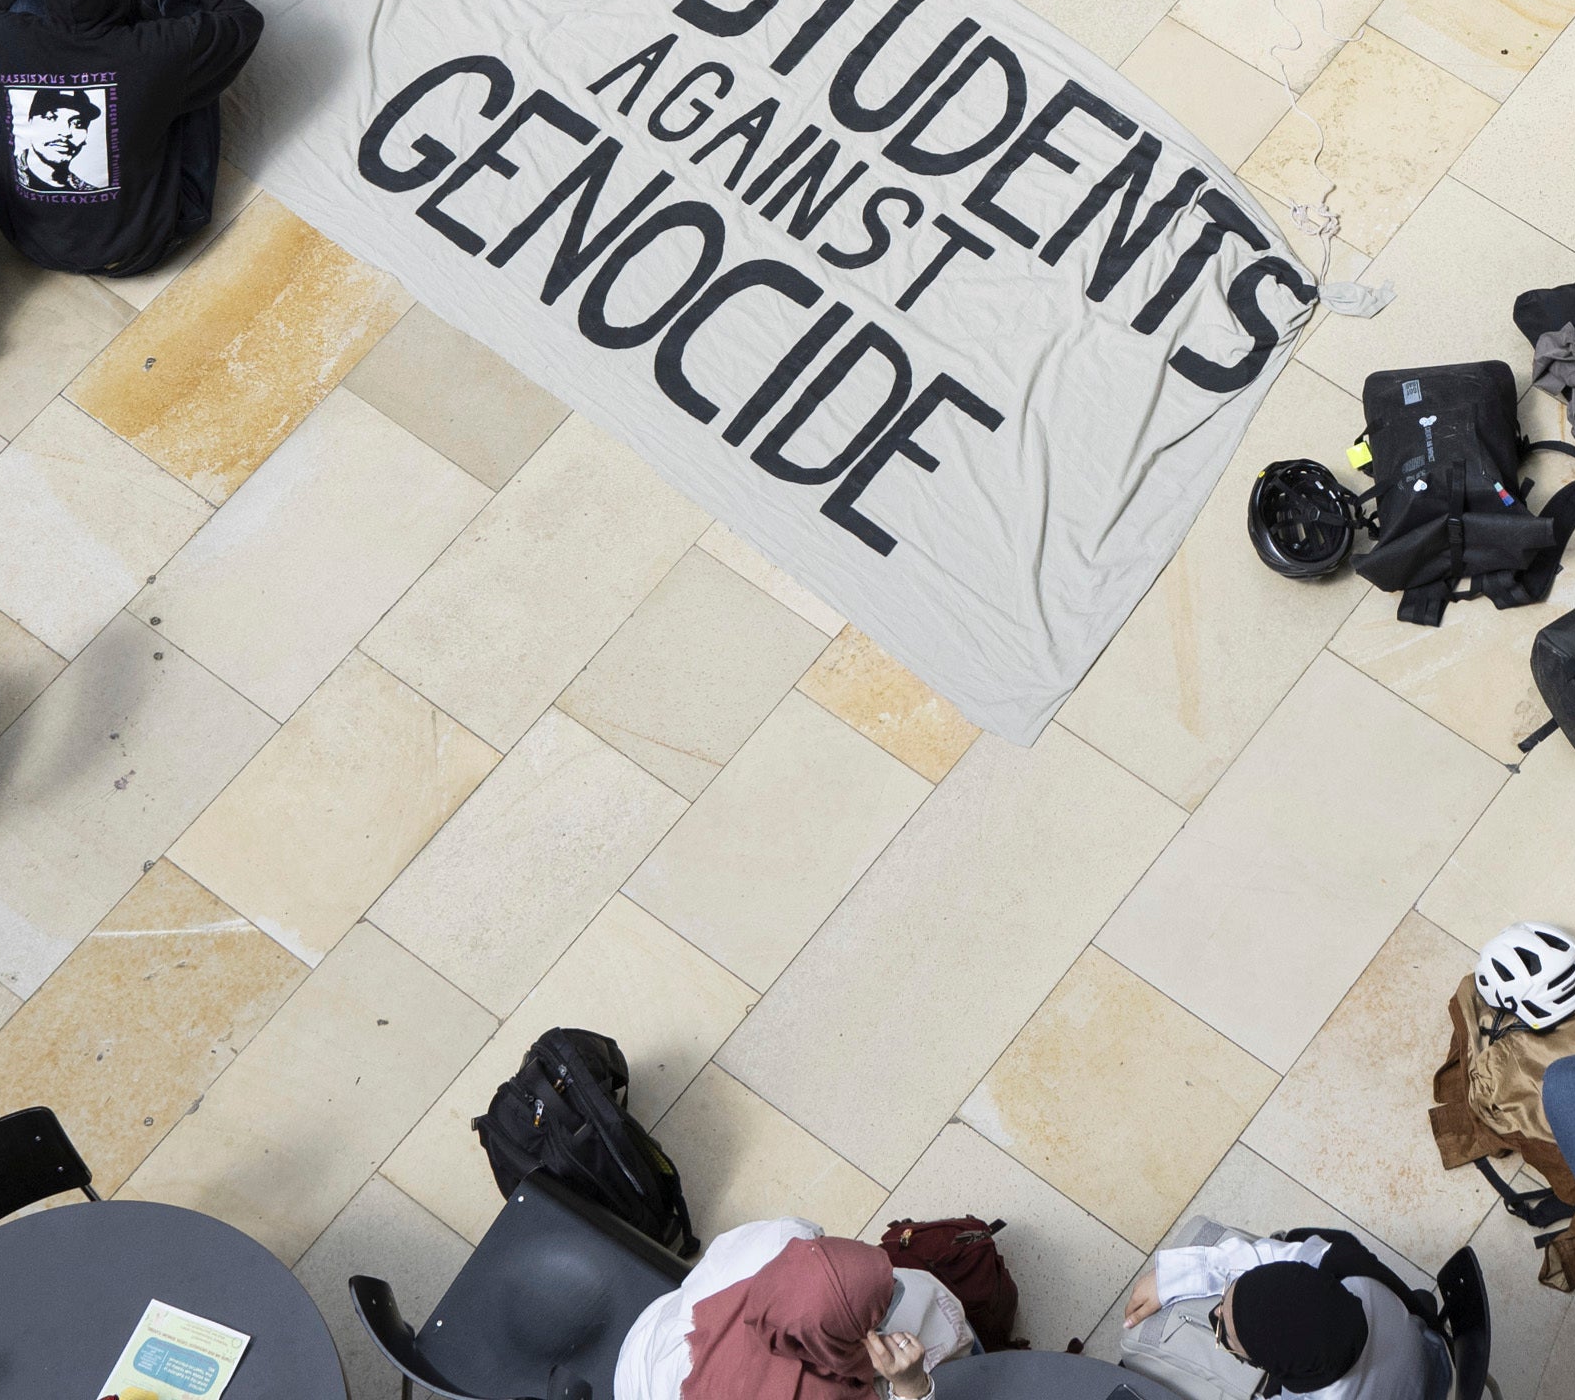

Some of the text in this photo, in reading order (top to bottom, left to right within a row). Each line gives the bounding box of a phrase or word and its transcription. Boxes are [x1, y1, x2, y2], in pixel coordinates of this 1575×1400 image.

[0, 72, 117, 84] RASSISMUS TÖTET
[587, 33, 995, 311] AGAINST
[357, 55, 1004, 556] GENOCIDE
